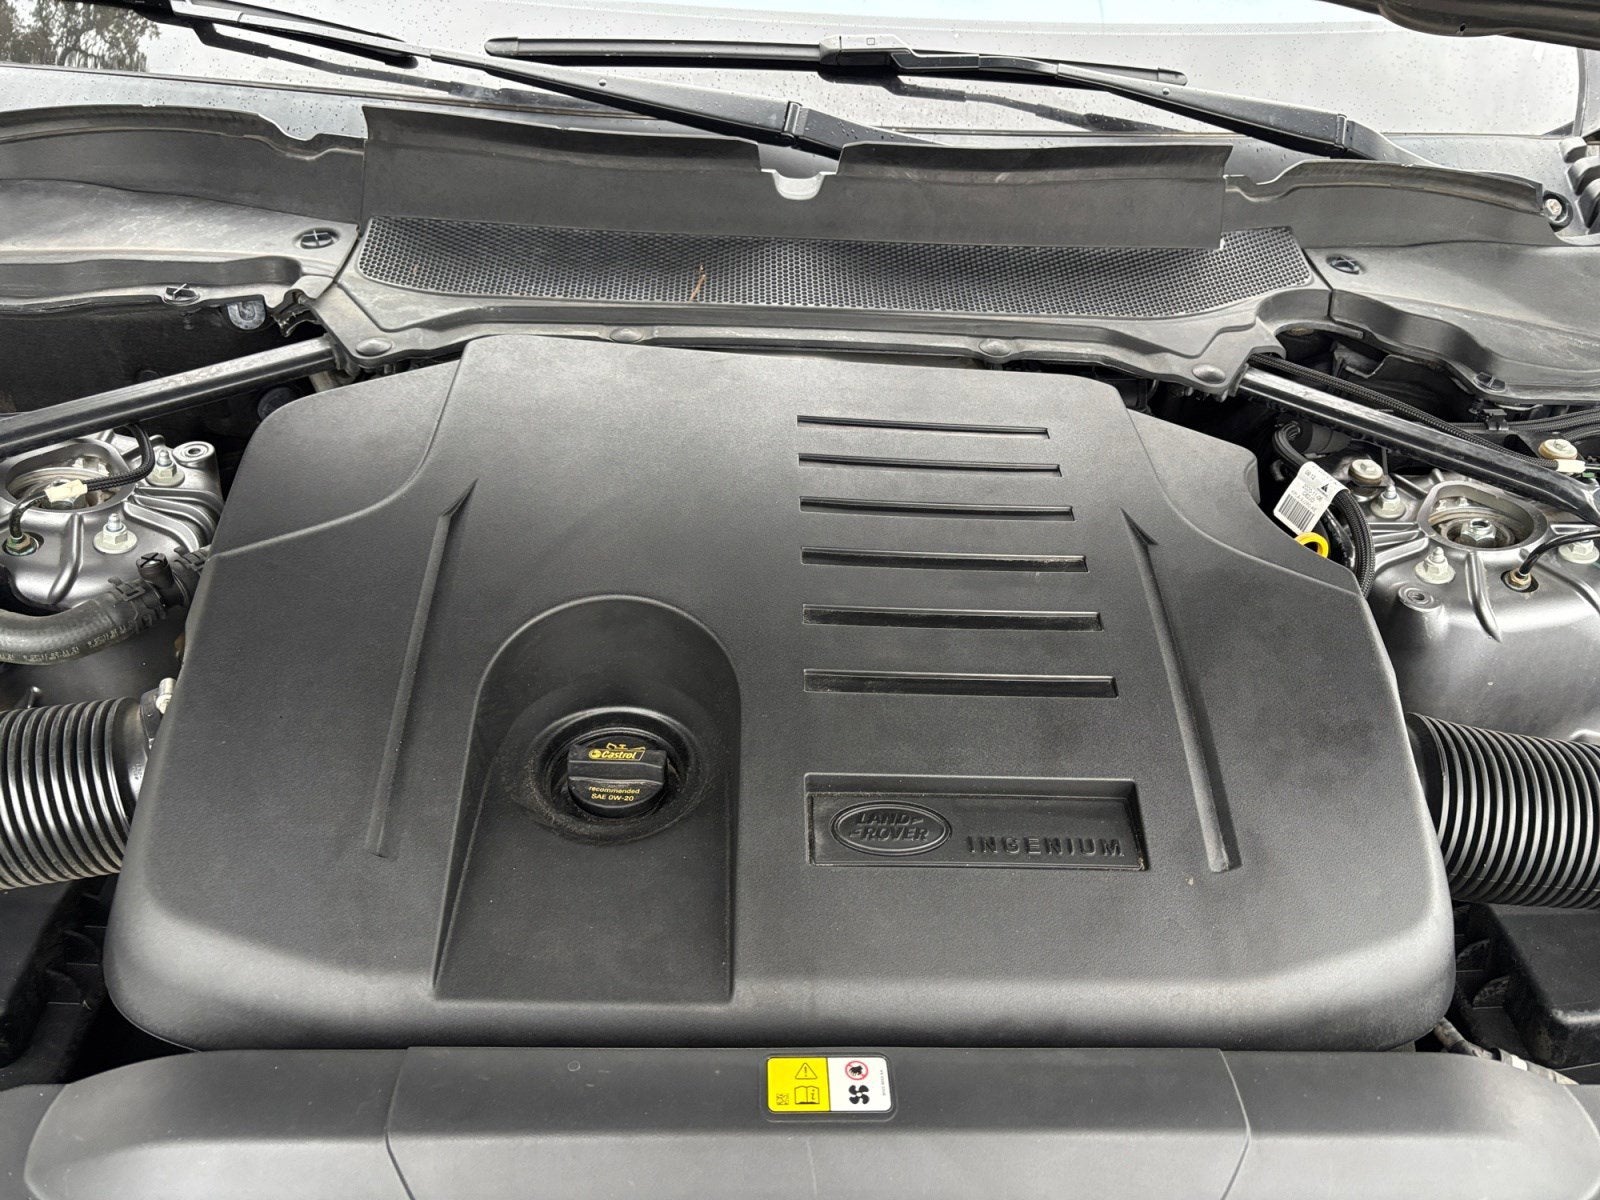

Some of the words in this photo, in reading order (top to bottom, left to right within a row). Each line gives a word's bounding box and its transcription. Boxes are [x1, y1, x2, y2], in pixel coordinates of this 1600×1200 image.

[601, 750, 637, 759] Castrol
[588, 785, 640, 794] recommended
[857, 811, 914, 826] LAND
[859, 826, 930, 841] ROVER
[965, 834, 1125, 857] INGENIUM
